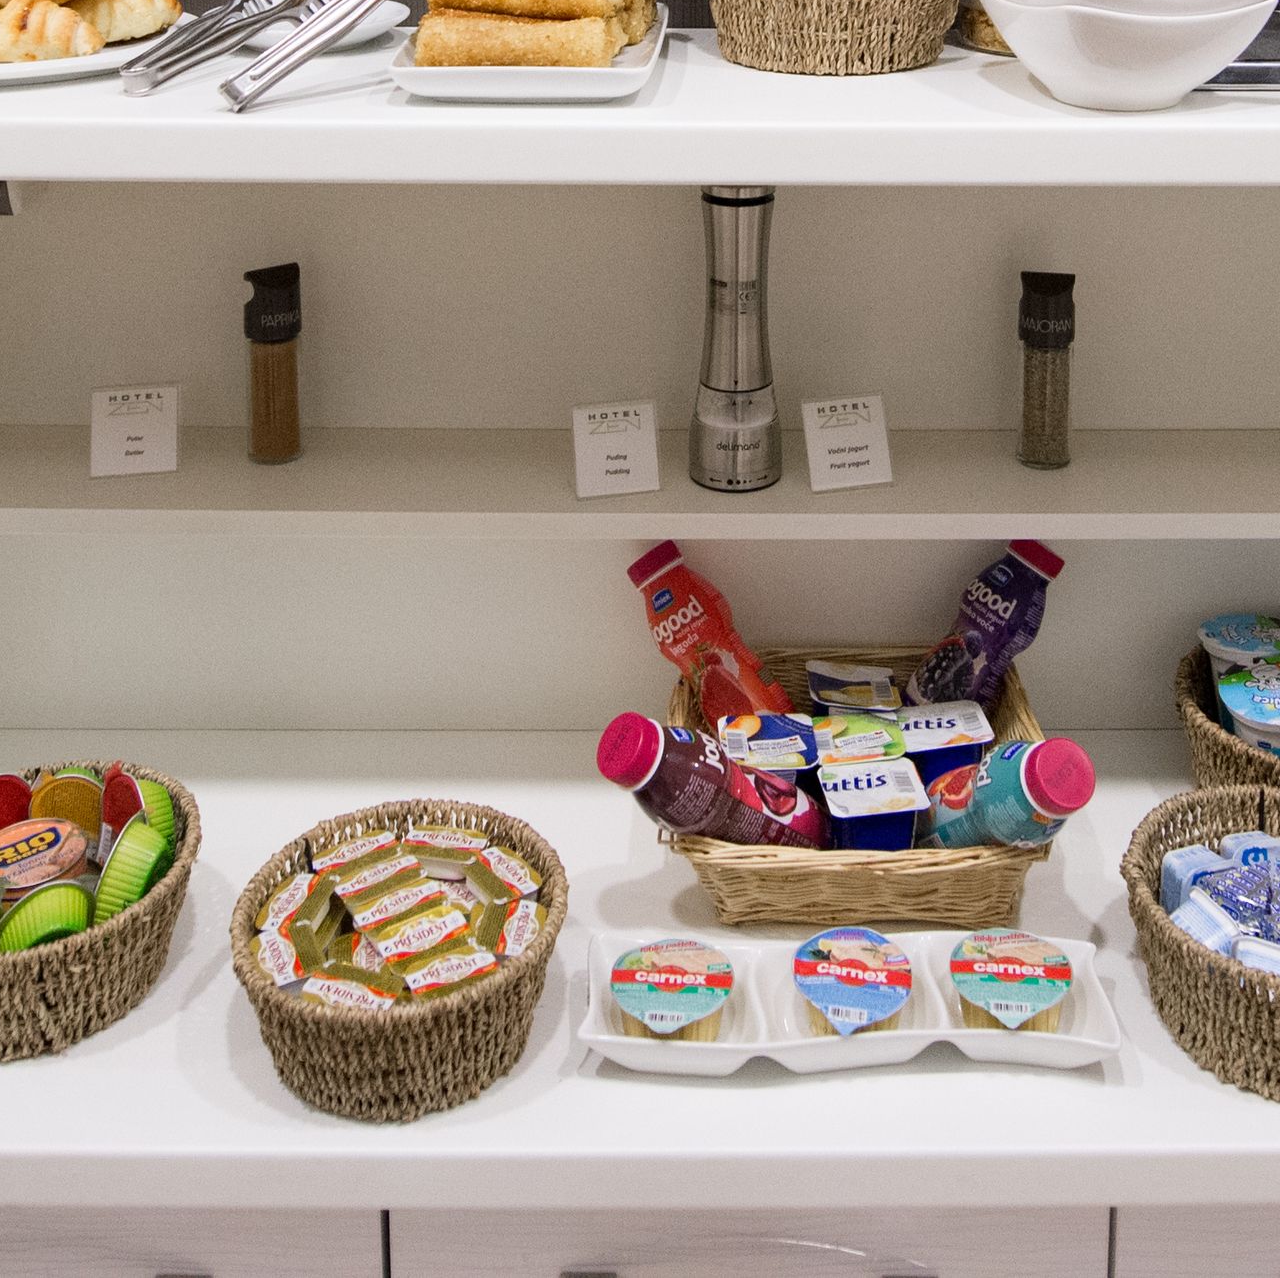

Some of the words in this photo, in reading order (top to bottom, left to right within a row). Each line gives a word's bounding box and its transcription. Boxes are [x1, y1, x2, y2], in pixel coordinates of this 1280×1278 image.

[1021, 315, 1072, 333] MAJORAN
[108, 393, 164, 403] HOTEL
[588, 410, 640, 421] HOTEL
[817, 403, 869, 415] HOTEL
[716, 441, 760, 452] delimano
[847, 460, 870, 468] yogurt
[966, 578, 1018, 620] ogood
[393, 919, 450, 949] PRESIDENT
[421, 957, 478, 982] PRESIDENT
[816, 963, 889, 983] carnex
[973, 962, 1046, 977] carnex
[634, 971, 707, 985] carnex
